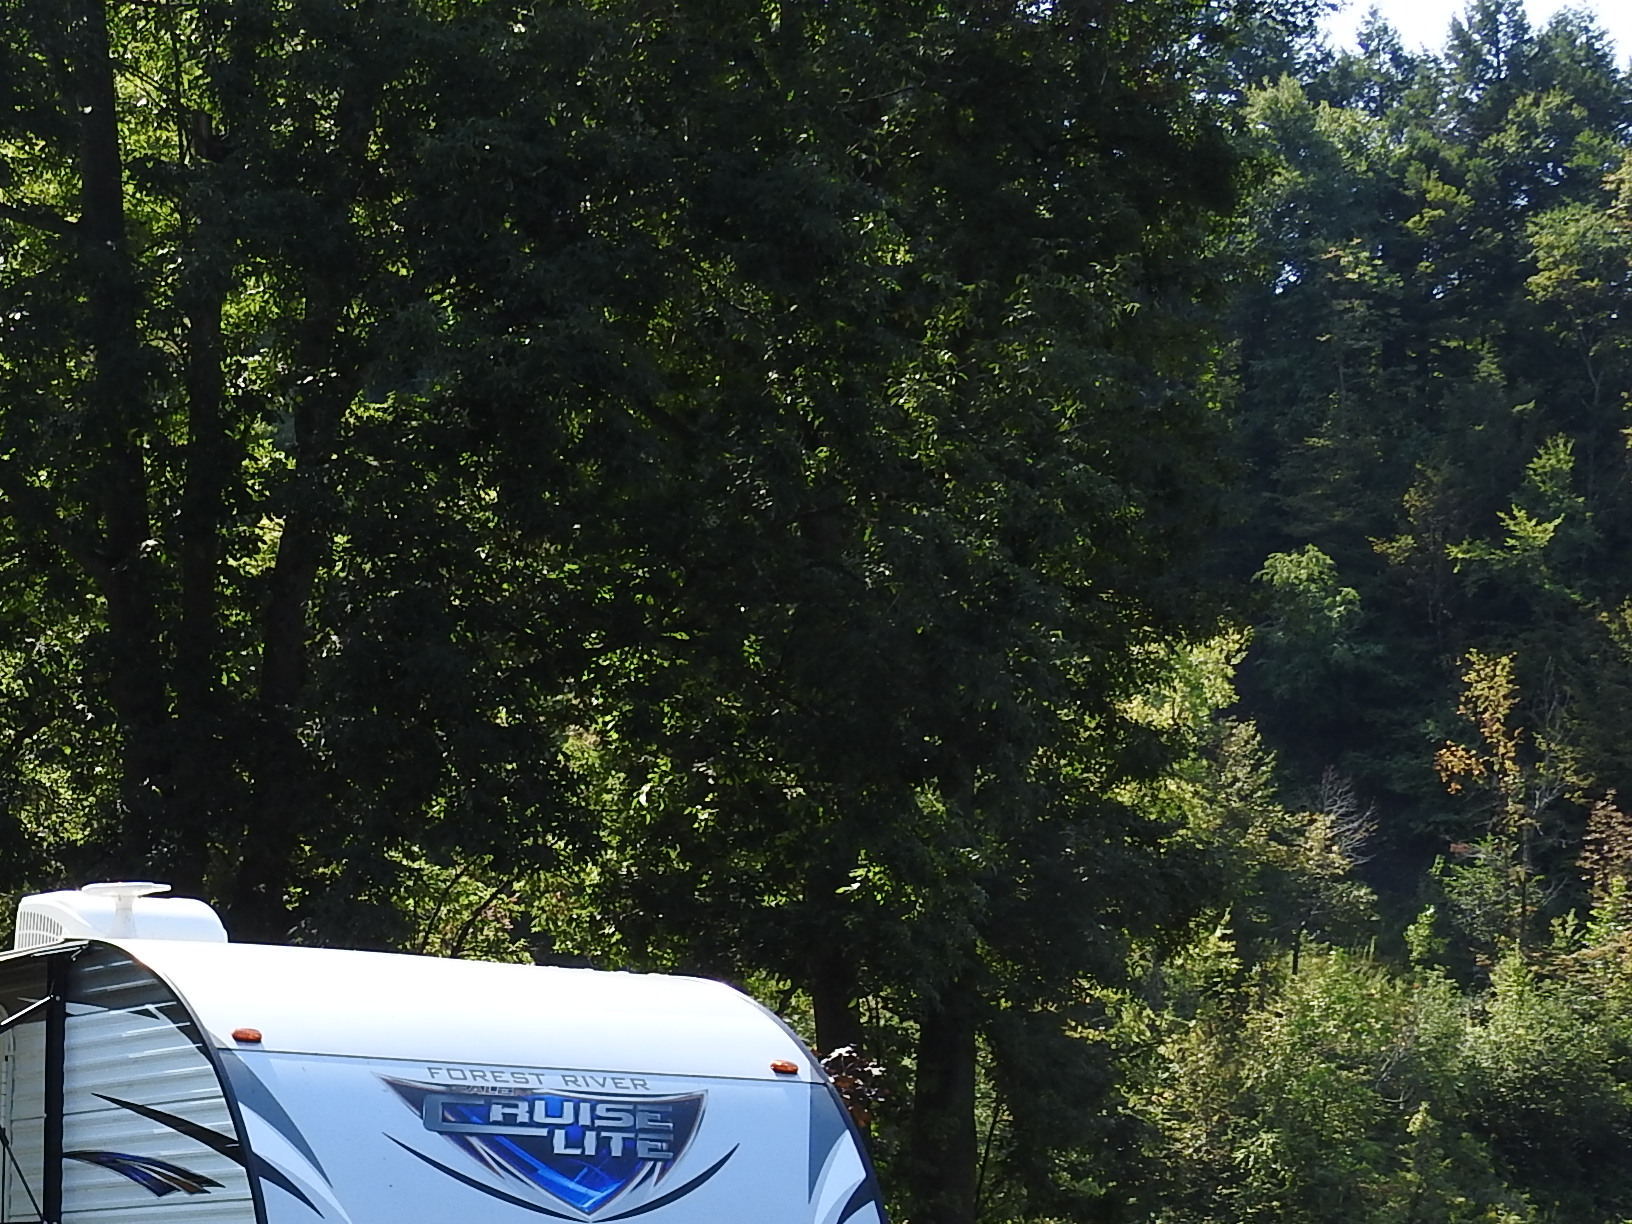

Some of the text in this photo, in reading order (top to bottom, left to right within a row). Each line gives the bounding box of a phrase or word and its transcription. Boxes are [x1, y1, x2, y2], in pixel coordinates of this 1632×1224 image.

[427, 1066, 651, 1091] FOREST RIVER
[422, 1094, 674, 1137] CRUISE
[552, 1128, 674, 1160] LITE
